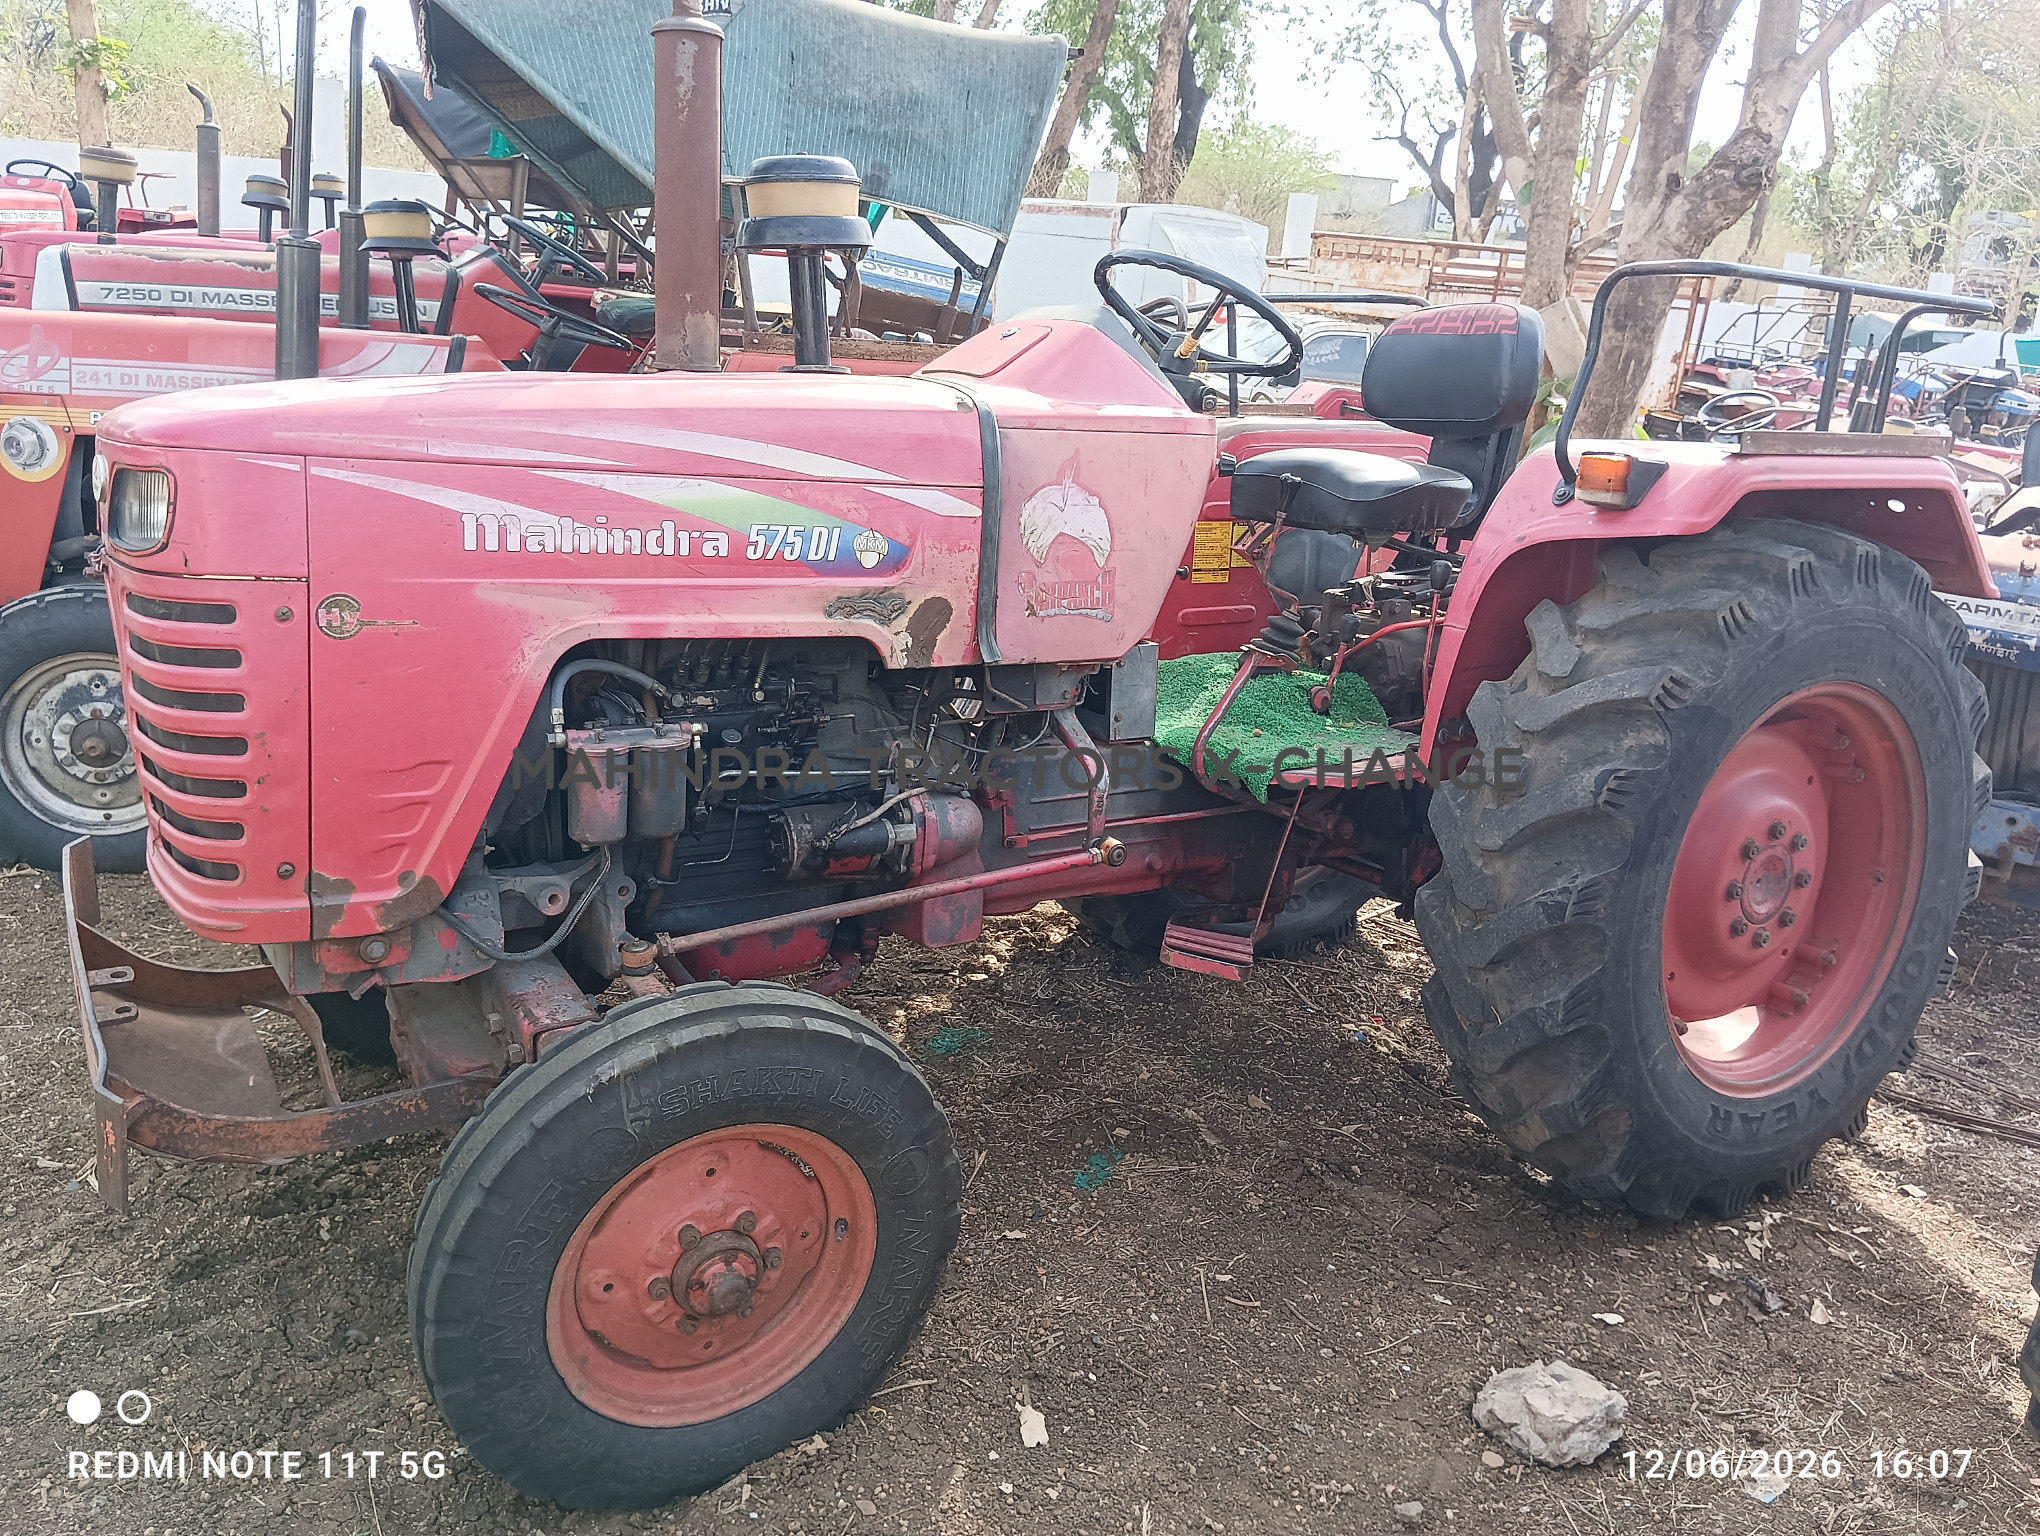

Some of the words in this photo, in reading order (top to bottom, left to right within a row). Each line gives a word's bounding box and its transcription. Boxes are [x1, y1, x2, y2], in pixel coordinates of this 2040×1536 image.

[100, 286, 162, 301] 7250
[171, 290, 193, 303] DI
[201, 291, 277, 308] MASS
[76, 370, 112, 385] 241
[120, 373, 139, 386] DI
[461, 512, 730, 558] Mahindra
[745, 523, 806, 562] 575
[806, 525, 841, 562] DI
[855, 535, 886, 553] MKM
[657, 1066, 824, 1122] SHAKTI
[829, 1076, 905, 1140] LIFE
